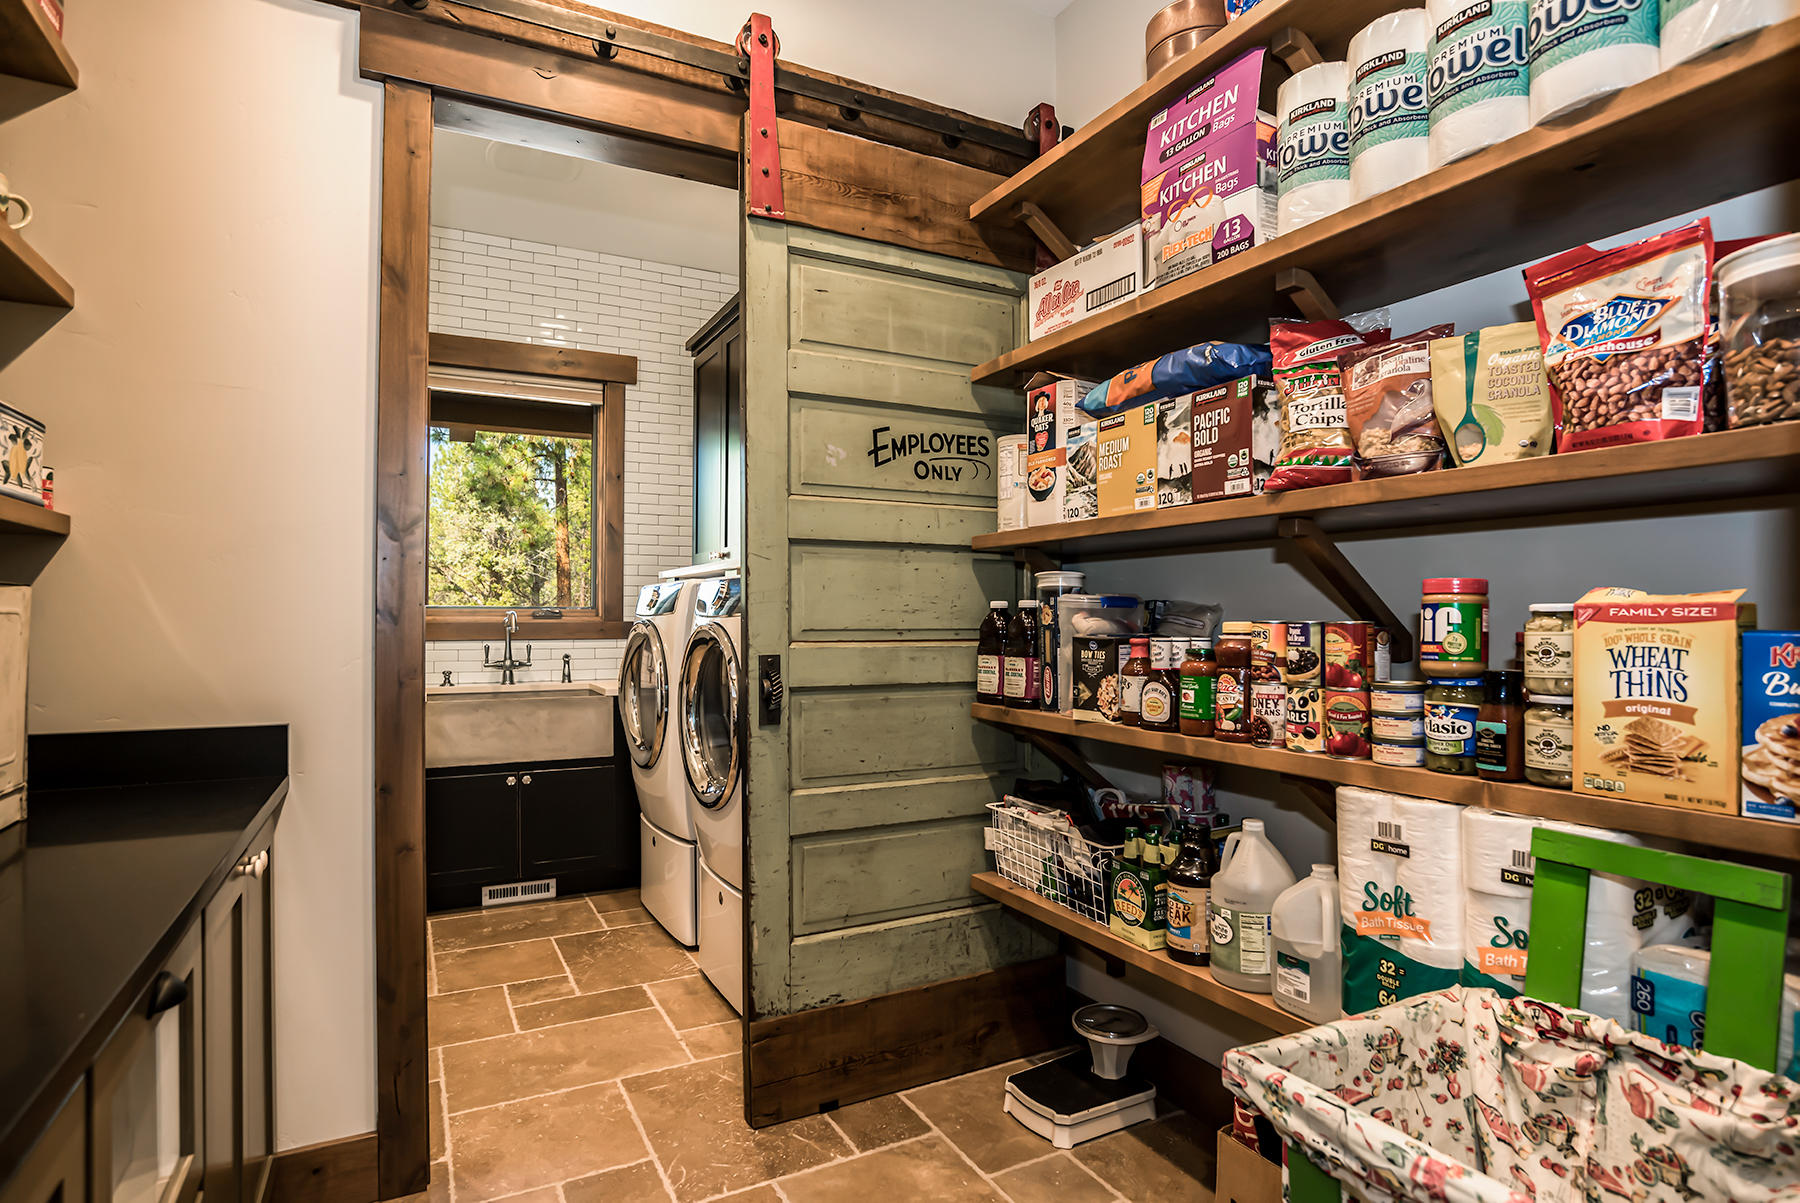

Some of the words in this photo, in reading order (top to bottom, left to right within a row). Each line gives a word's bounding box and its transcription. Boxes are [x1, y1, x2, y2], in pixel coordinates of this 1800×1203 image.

[1437, 1, 1490, 37] KIRKLAND
[1433, 27, 1500, 66] PREMIUM
[1356, 51, 1405, 78] KIRKLAND
[1428, 27, 1528, 93] owel
[1160, 84, 1240, 149] KITCHEN
[1290, 98, 1335, 122] KIRKLAND
[1212, 113, 1236, 134] Bags
[1286, 121, 1345, 145] PREMIUM
[1165, 147, 1175, 159] 13
[1175, 127, 1207, 153] GALLON
[1159, 155, 1228, 208] KITCHEN
[1214, 176, 1239, 195] Bags
[1222, 218, 1241, 239] 13
[1216, 246, 1230, 260] 200
[1230, 239, 1250, 255] BAGS
[1565, 301, 1663, 342] DIAMOND
[1593, 299, 1642, 325] BLUE
[1299, 341, 1334, 358] Gluten
[1334, 335, 1359, 347] Free
[1564, 336, 1657, 362] Smokehouse
[1487, 360, 1542, 378] TOASTED
[1487, 372, 1542, 389] COCONUT
[1195, 387, 1228, 403] KIRKLAND
[1487, 384, 1542, 401] GRANOLA
[1290, 397, 1349, 416] Tortilla
[1030, 412, 1054, 428] QUAKER
[1193, 406, 1232, 432] PACIFIC
[1294, 412, 1346, 427] Chips
[867, 425, 991, 469] EMPLOYEES
[1099, 436, 1130, 457] MEDIUM
[1193, 426, 1219, 448] BOLD
[913, 459, 964, 482] ONLY
[1098, 452, 1123, 472] ROAST
[1158, 491, 1174, 506] 120
[1066, 506, 1080, 519] 120
[1609, 607, 1669, 617] FAMILY
[1671, 607, 1717, 617] SIZE!
[1251, 629, 1269, 640] SH'S
[1421, 606, 1463, 643] if
[1624, 632, 1658, 644] WHOLE
[1659, 634, 1693, 649] GRAIN
[1080, 649, 1093, 660] BOW
[1093, 649, 1106, 660] TIES
[1606, 645, 1690, 672] WHEAT
[1252, 698, 1280, 709] DNEY
[1255, 708, 1281, 717] BEANS
[1625, 704, 1672, 717] original
[1287, 710, 1308, 723] ARLS
[1597, 724, 1611, 732] NO
[1372, 841, 1385, 851] DG
[1387, 843, 1409, 855] home
[1503, 871, 1520, 883] DG
[1361, 880, 1416, 919] Soft
[1635, 888, 1654, 912] 32
[1168, 911, 1191, 924] EAK
[1360, 916, 1386, 929] Bath
[1385, 917, 1425, 933] Tissue
[1490, 915, 1529, 951] So
[1379, 959, 1396, 976] 32
[1485, 952, 1519, 969] Bath
[1377, 990, 1397, 1006] 64
[1637, 981, 1651, 1011] 260
